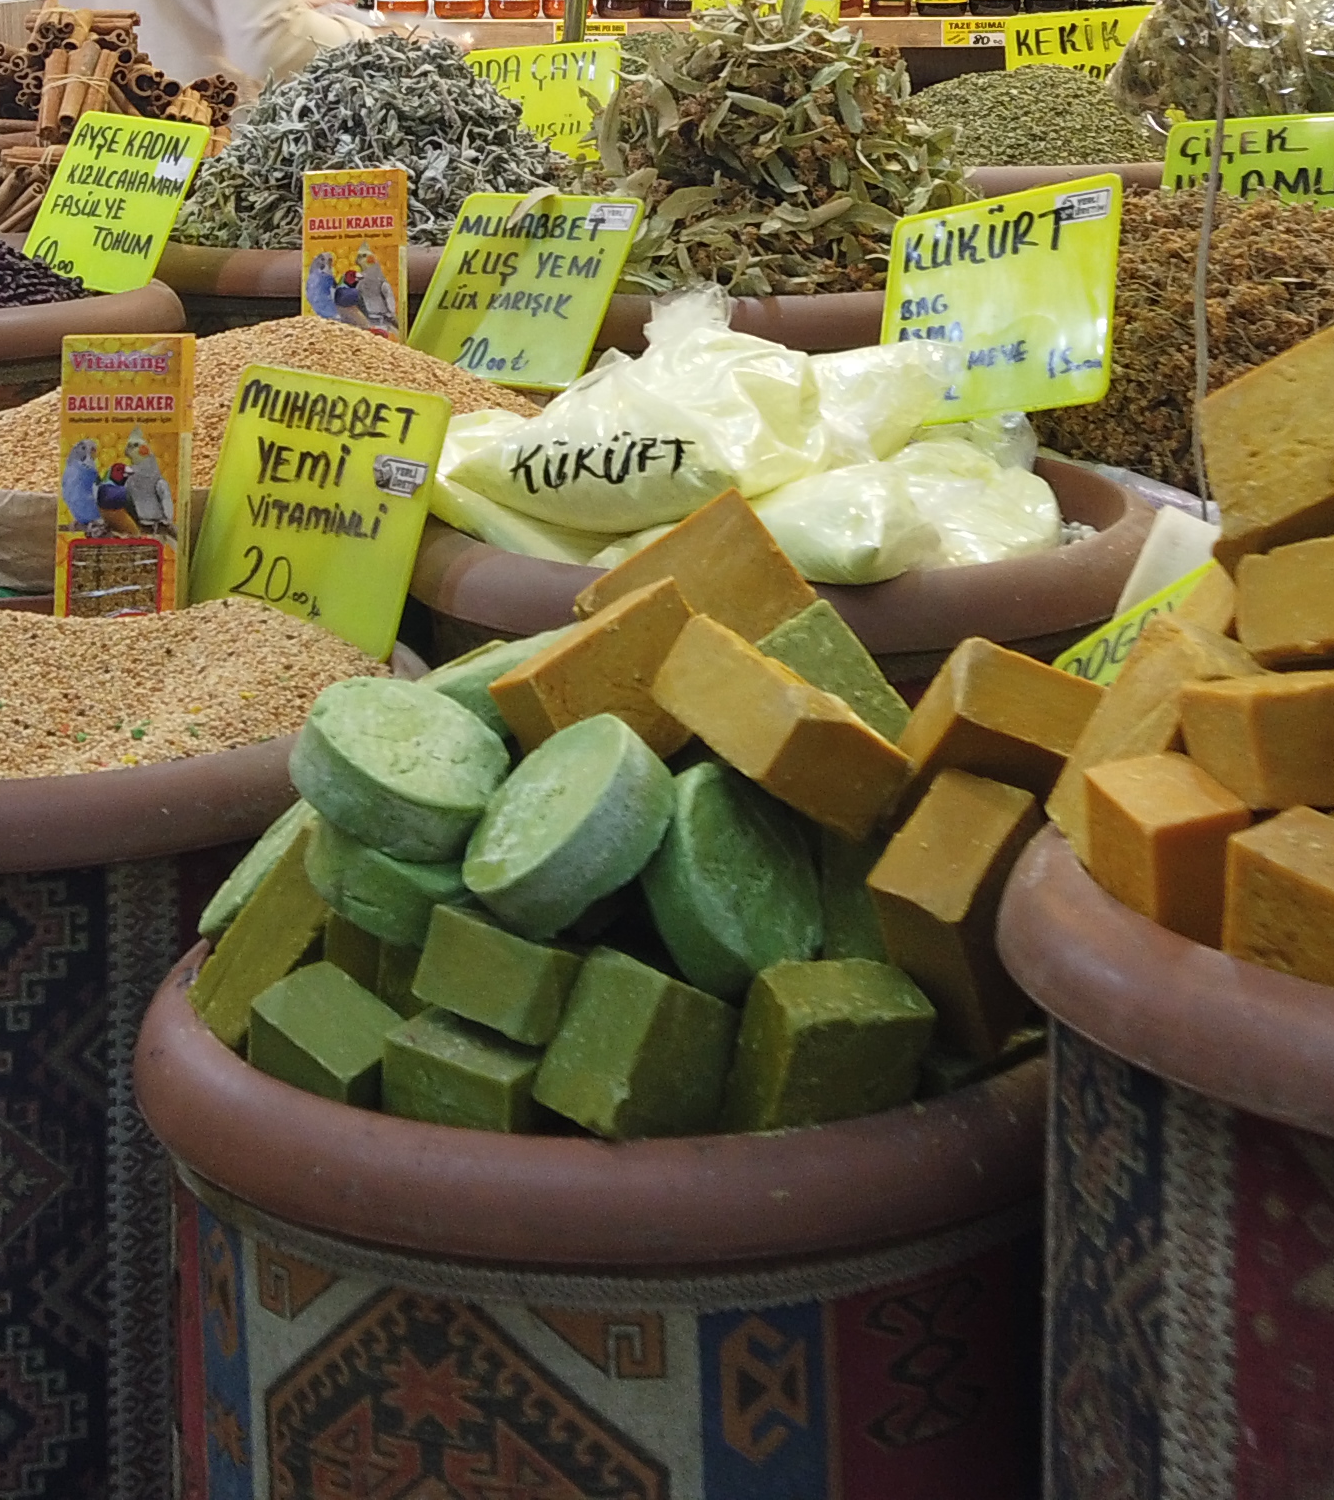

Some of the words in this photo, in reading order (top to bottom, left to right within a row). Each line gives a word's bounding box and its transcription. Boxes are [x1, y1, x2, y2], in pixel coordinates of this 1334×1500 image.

[975, 22, 1005, 31] SUMA
[1015, 18, 1126, 57] KEKİK
[531, 50, 596, 91] ÇAYI
[73, 123, 123, 160] AYŞE
[123, 129, 190, 166] KADIN
[309, 180, 389, 200] Vitaking
[309, 216, 344, 232] BALLI
[346, 215, 394, 230] KRAKER
[457, 214, 606, 242] MUHABBET
[903, 204, 1074, 274] KÜKÜRT
[93, 225, 153, 260] TOHUM
[458, 249, 518, 286] KUŞ
[535, 247, 606, 279] YEMİ
[486, 291, 573, 319] KARIŞIK
[70, 350, 170, 375] Vitaking
[67, 396, 109, 412] BALLI
[114, 395, 174, 412] KRAKER
[238, 379, 420, 445] MUHABBET
[256, 436, 351, 490] YEMİ
[247, 494, 389, 540] VİTAMİNLİ
